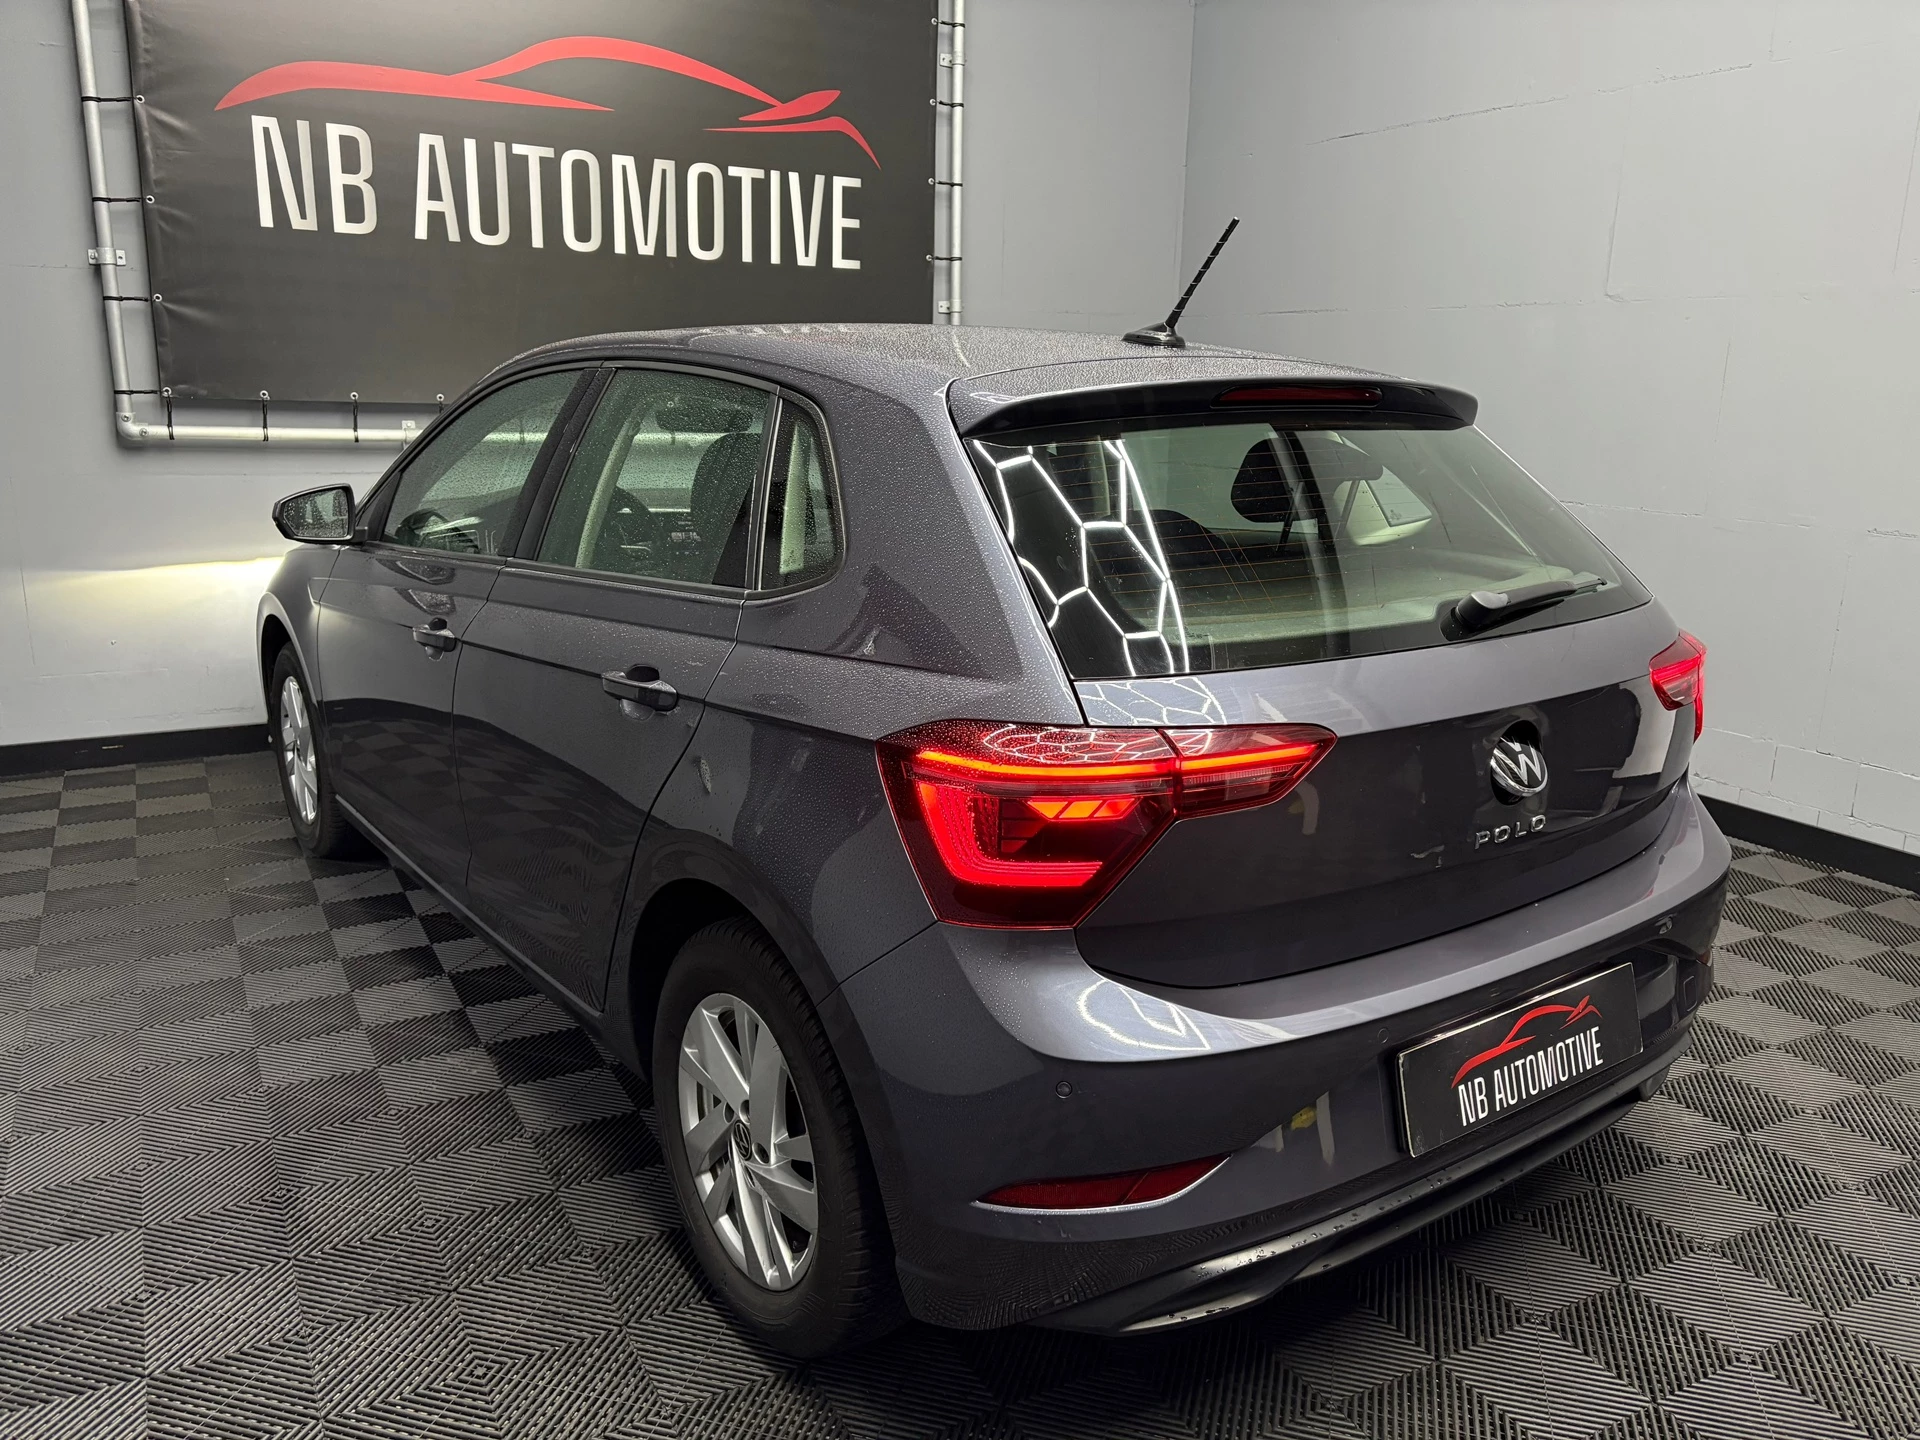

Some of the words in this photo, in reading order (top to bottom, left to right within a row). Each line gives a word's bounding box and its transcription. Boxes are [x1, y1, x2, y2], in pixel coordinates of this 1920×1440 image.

[251, 115, 378, 235] NB
[414, 133, 862, 270] AUTOMOTIVE
[1474, 814, 1546, 850] POLO
[1458, 1076, 1489, 1127] NB
[1493, 1026, 1604, 1112] AUTOMOTIVE
